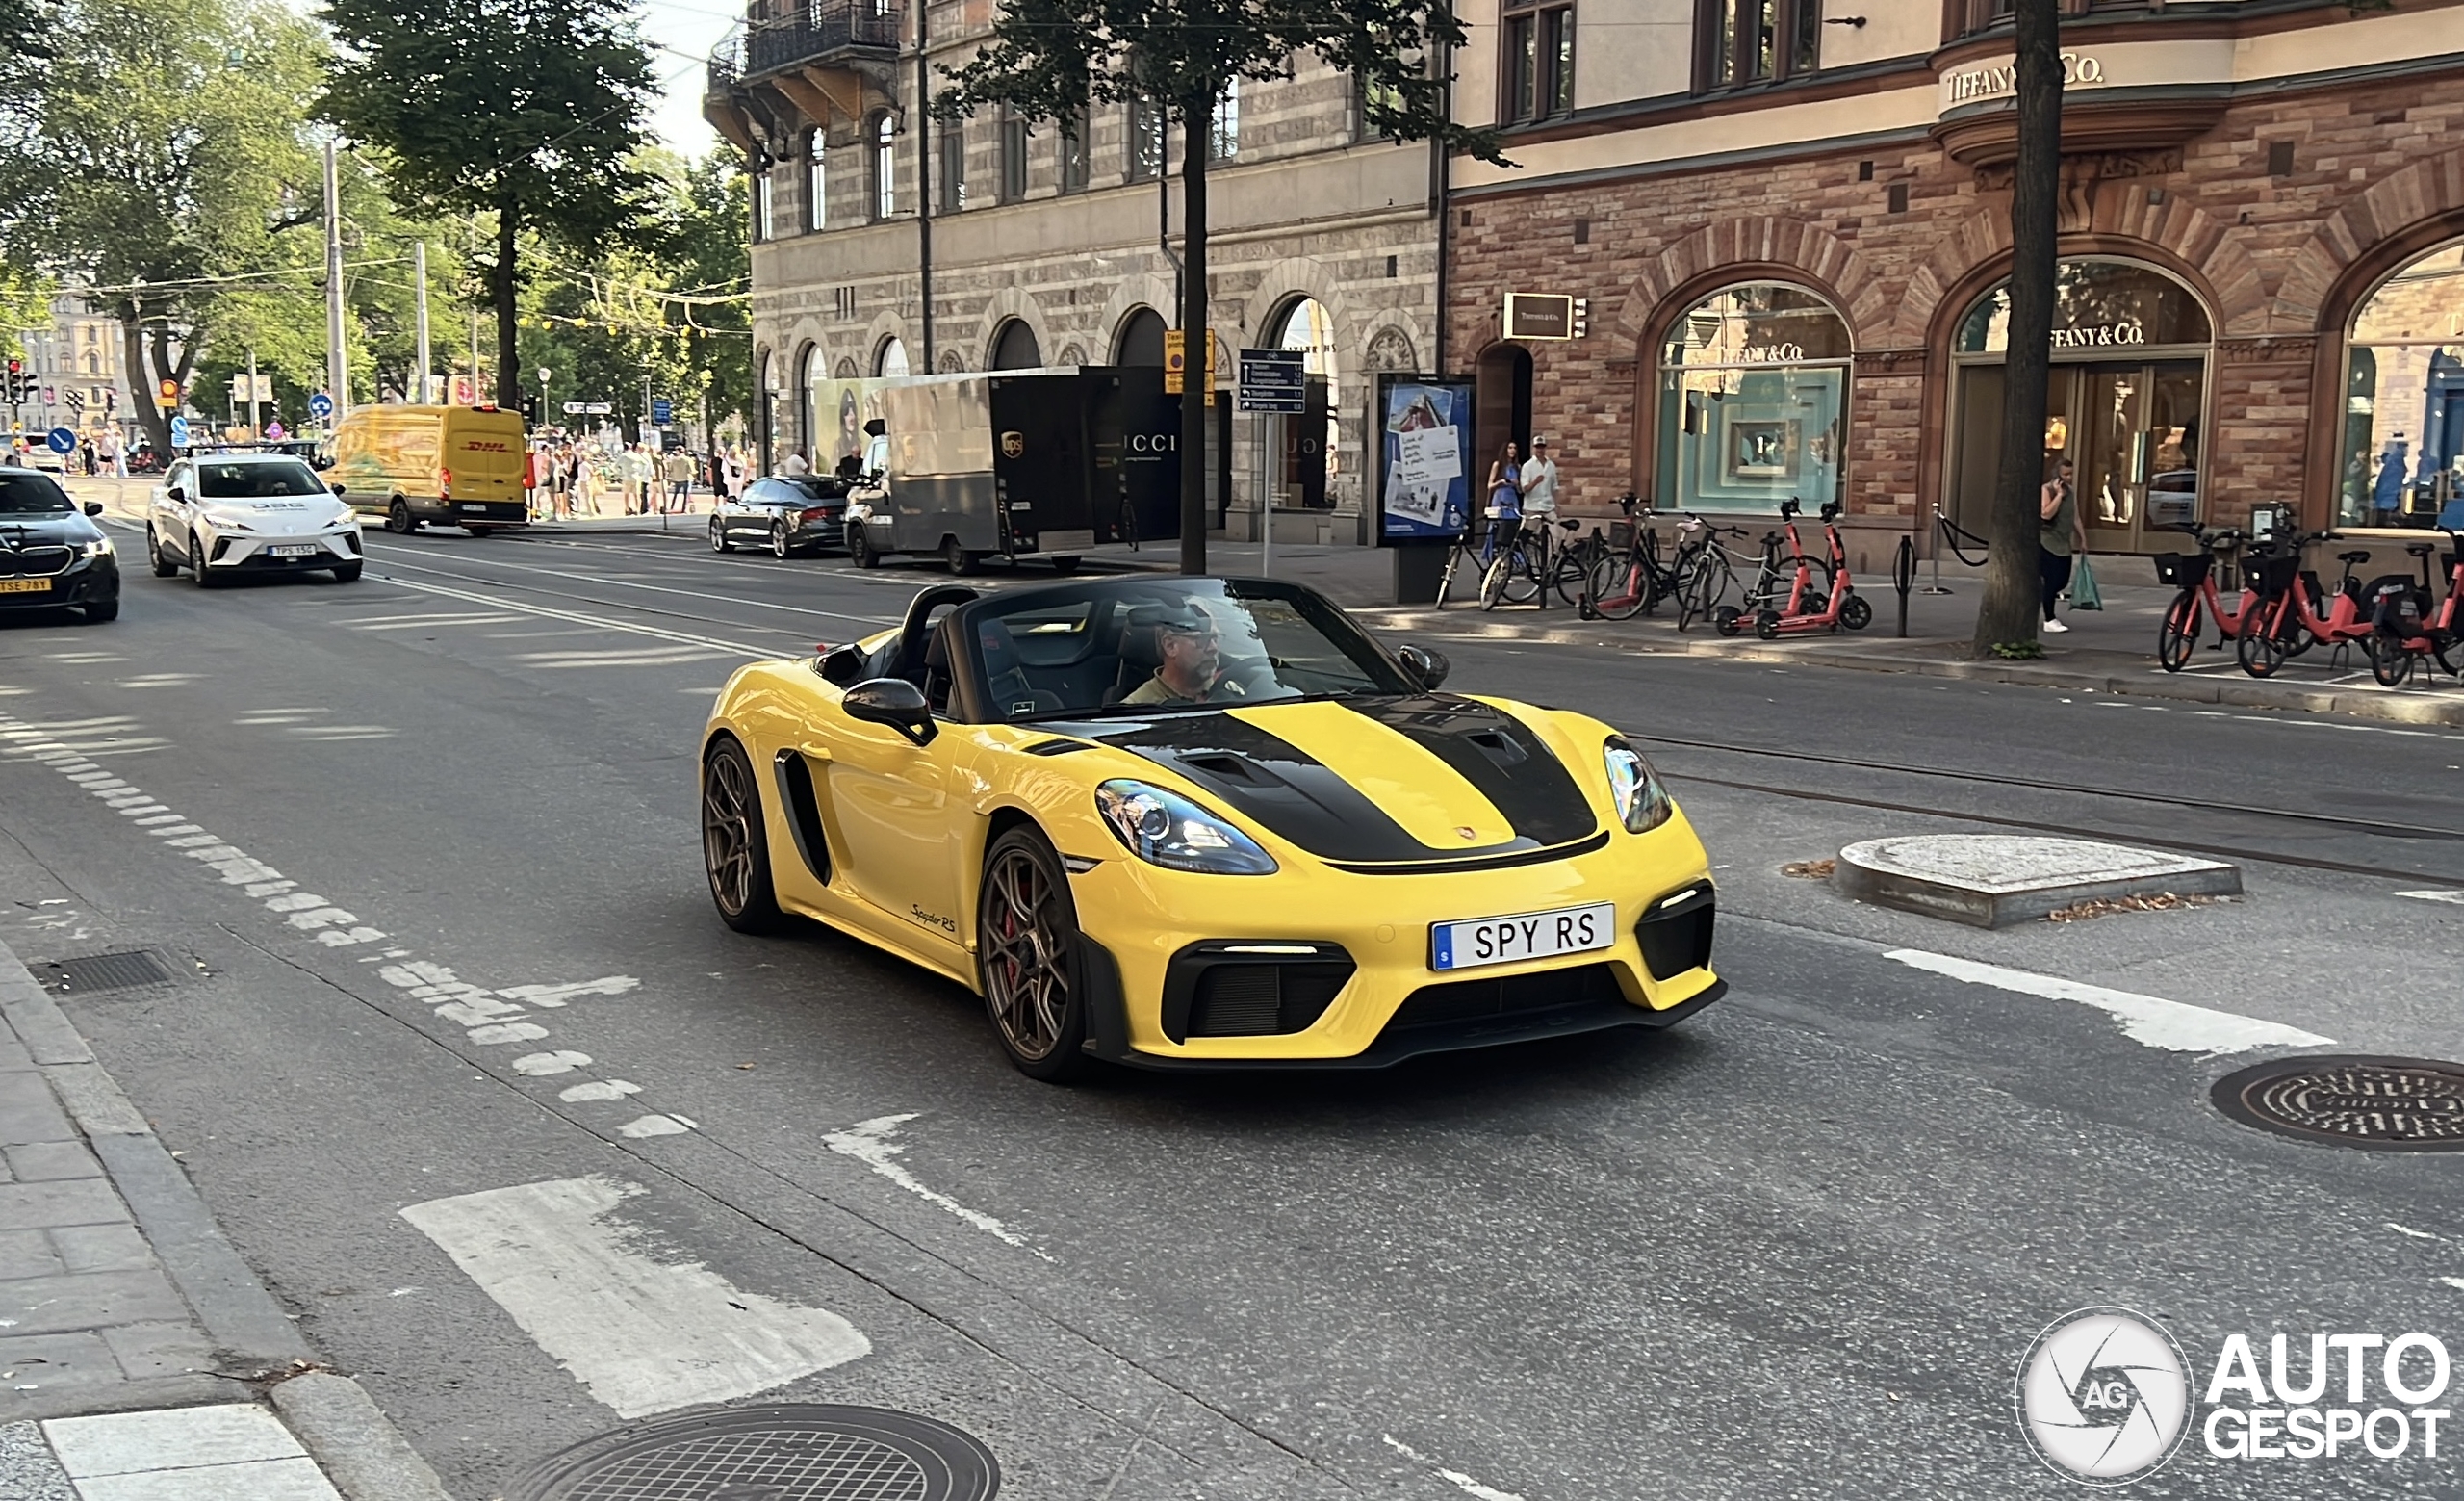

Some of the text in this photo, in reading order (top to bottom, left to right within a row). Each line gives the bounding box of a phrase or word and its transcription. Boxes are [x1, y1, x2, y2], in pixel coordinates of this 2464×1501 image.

[468, 441, 507, 453] DHL
[276, 546, 295, 556] TPS
[910, 903, 956, 933] Spyder RS
[1476, 919, 1539, 959] SPY
[1556, 913, 1595, 949] RS
